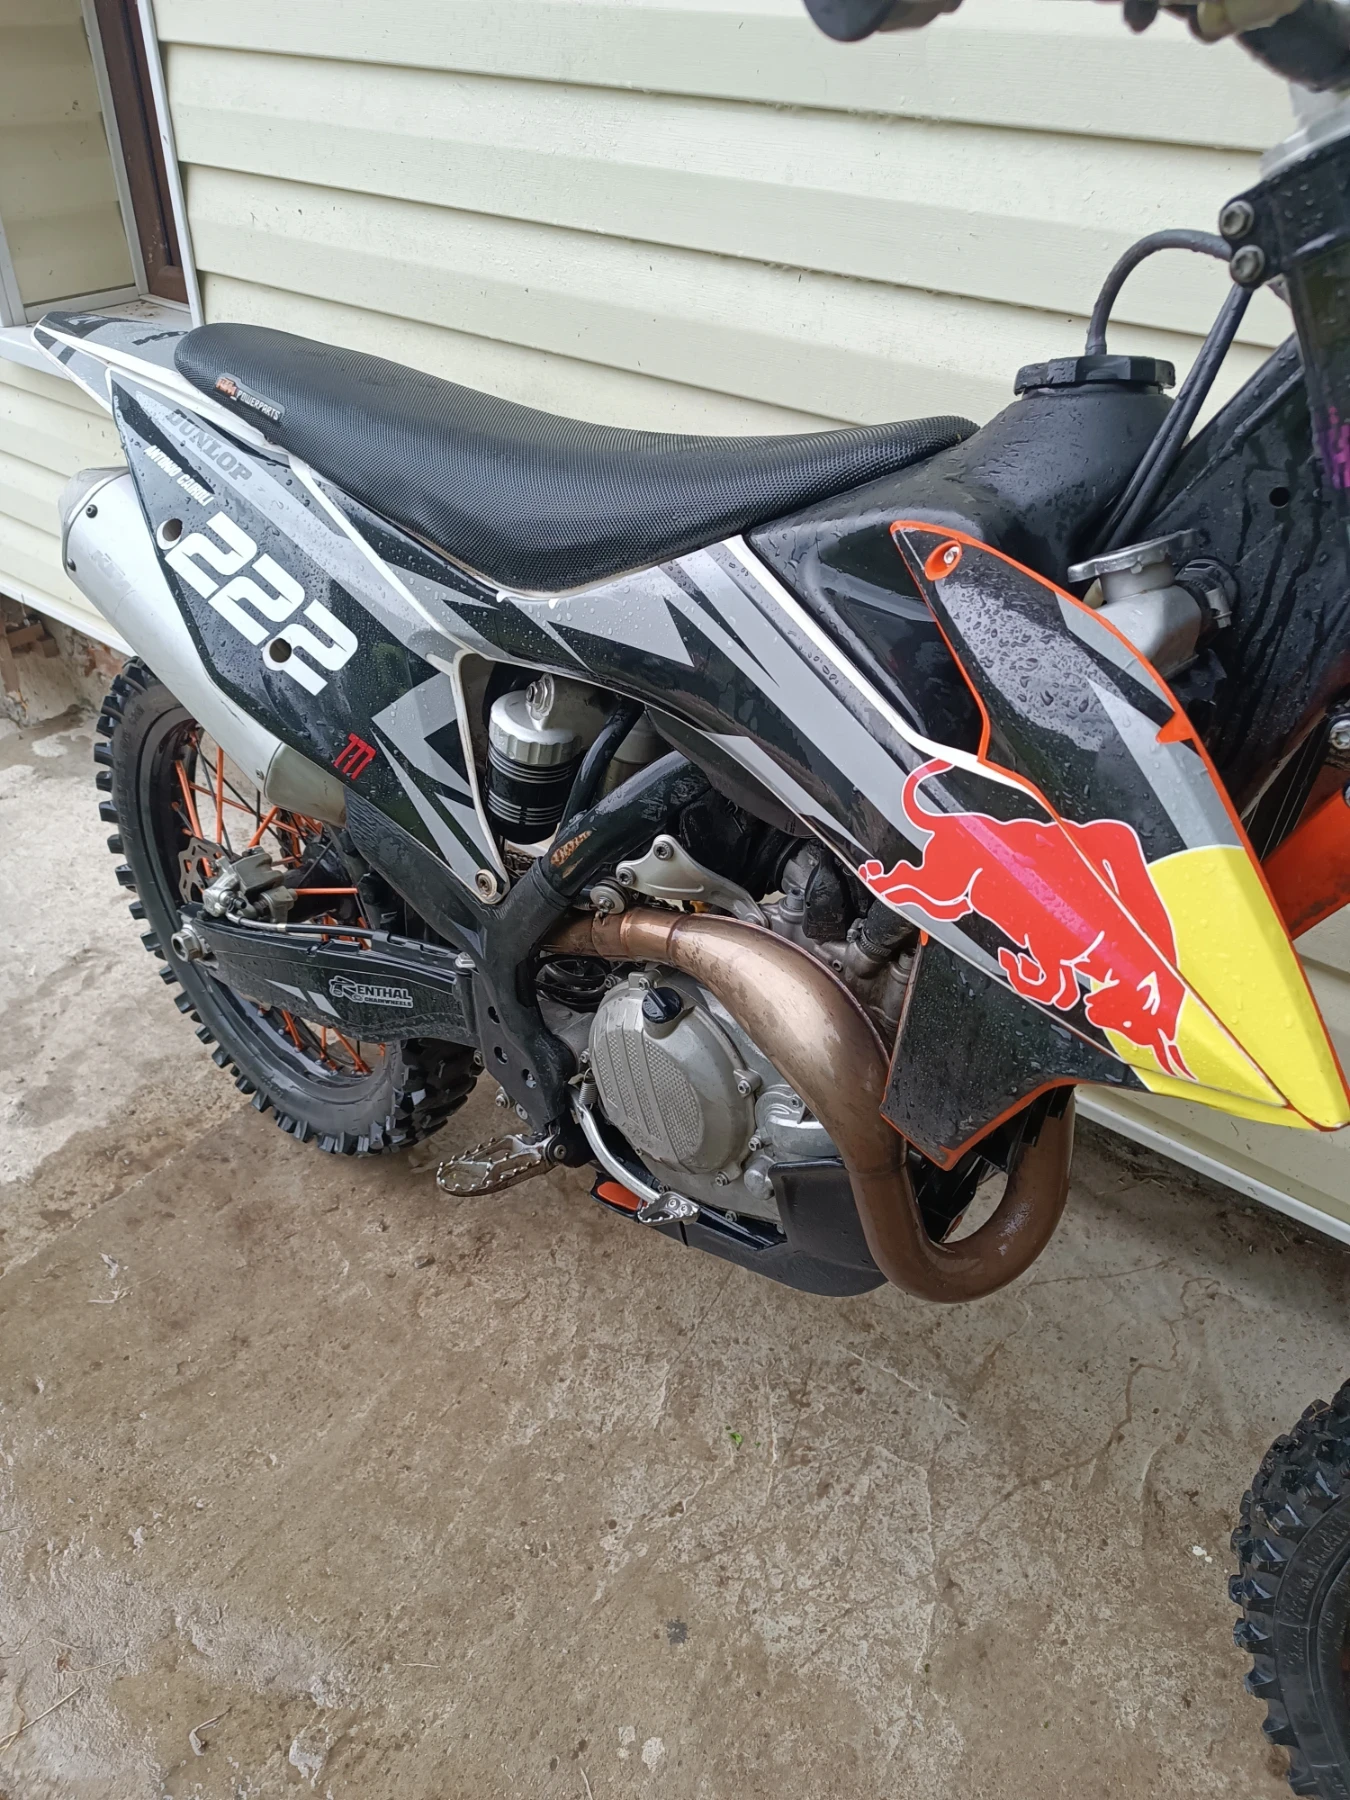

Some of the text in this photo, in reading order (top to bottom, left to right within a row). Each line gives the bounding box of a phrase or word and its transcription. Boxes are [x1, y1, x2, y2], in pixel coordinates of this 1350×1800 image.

[236, 390, 281, 420] POWERPARTS
[166, 409, 252, 481] DUNLOP
[144, 444, 215, 507] ANTONIO CAIROLI
[164, 511, 358, 697] 222
[328, 975, 411, 1003] RENTHAL
[363, 996, 413, 1008] CHAINWHEELS
